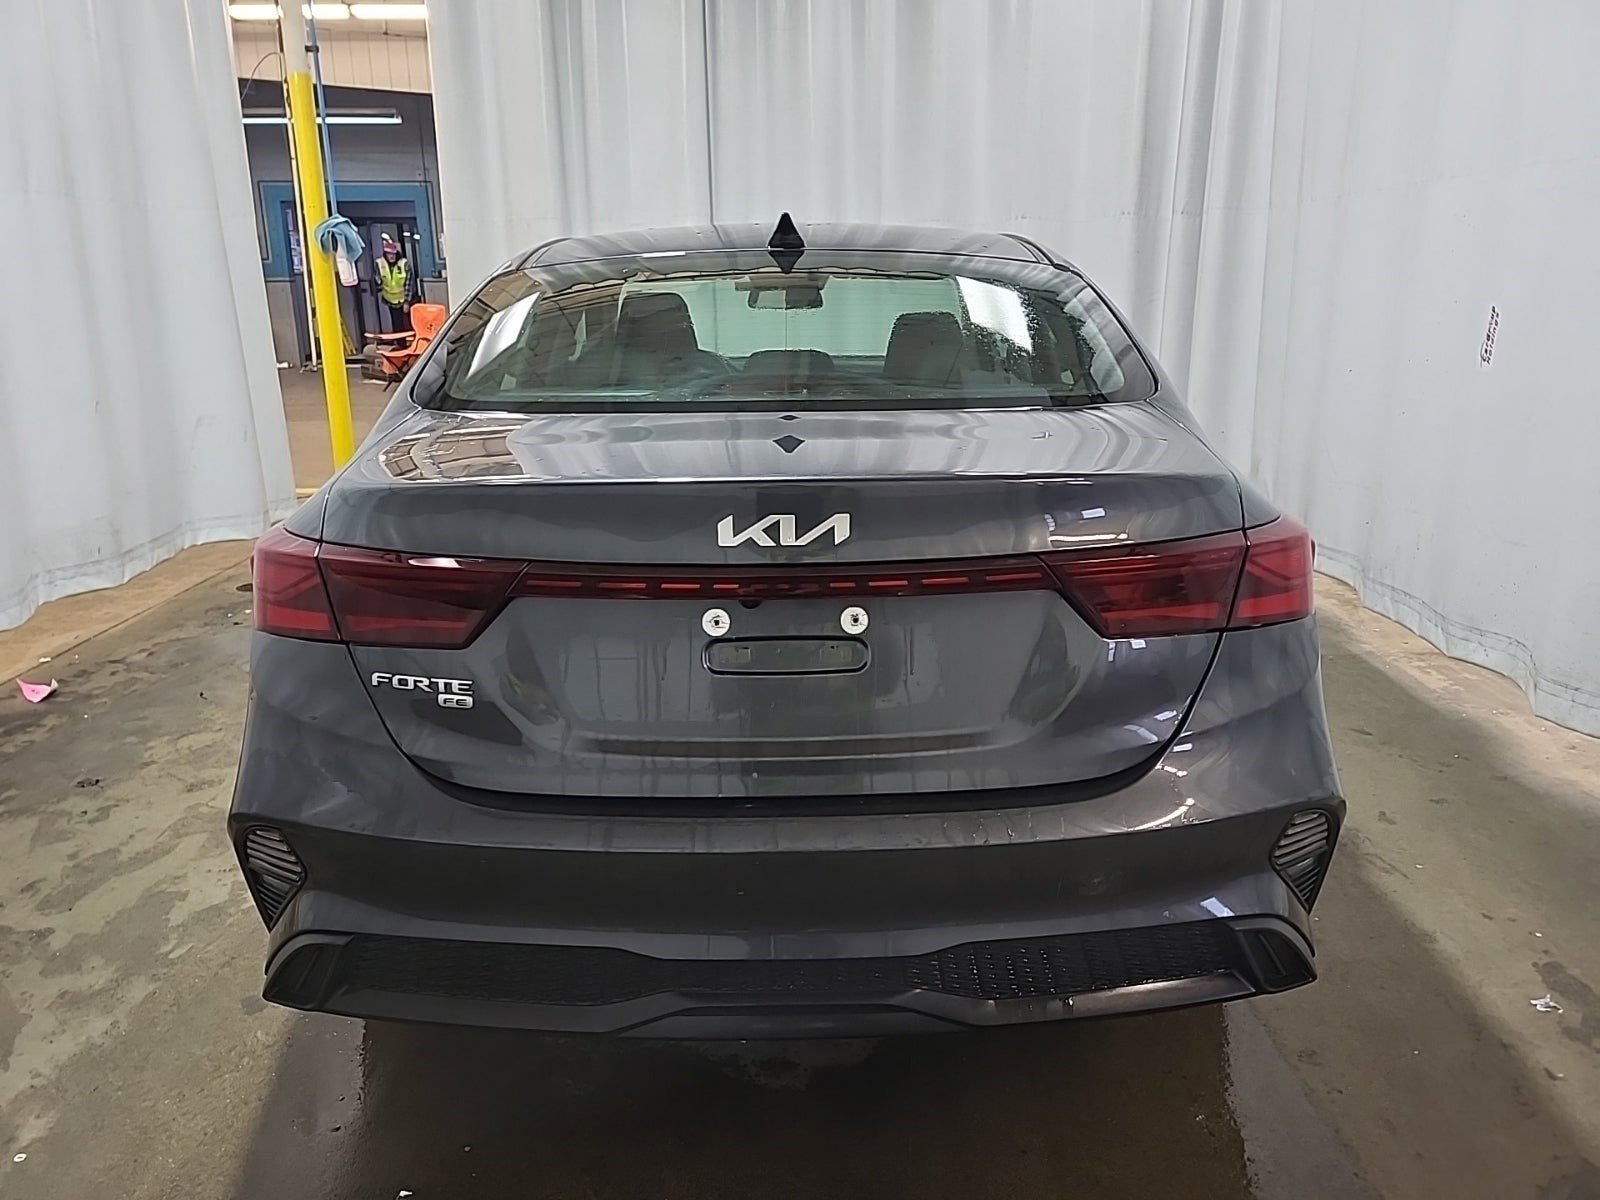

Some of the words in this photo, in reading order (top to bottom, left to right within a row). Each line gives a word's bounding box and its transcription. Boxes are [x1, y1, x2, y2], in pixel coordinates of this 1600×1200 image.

[717, 513, 850, 547] KIA
[371, 672, 473, 694] FORTE
[442, 696, 469, 707] FE
